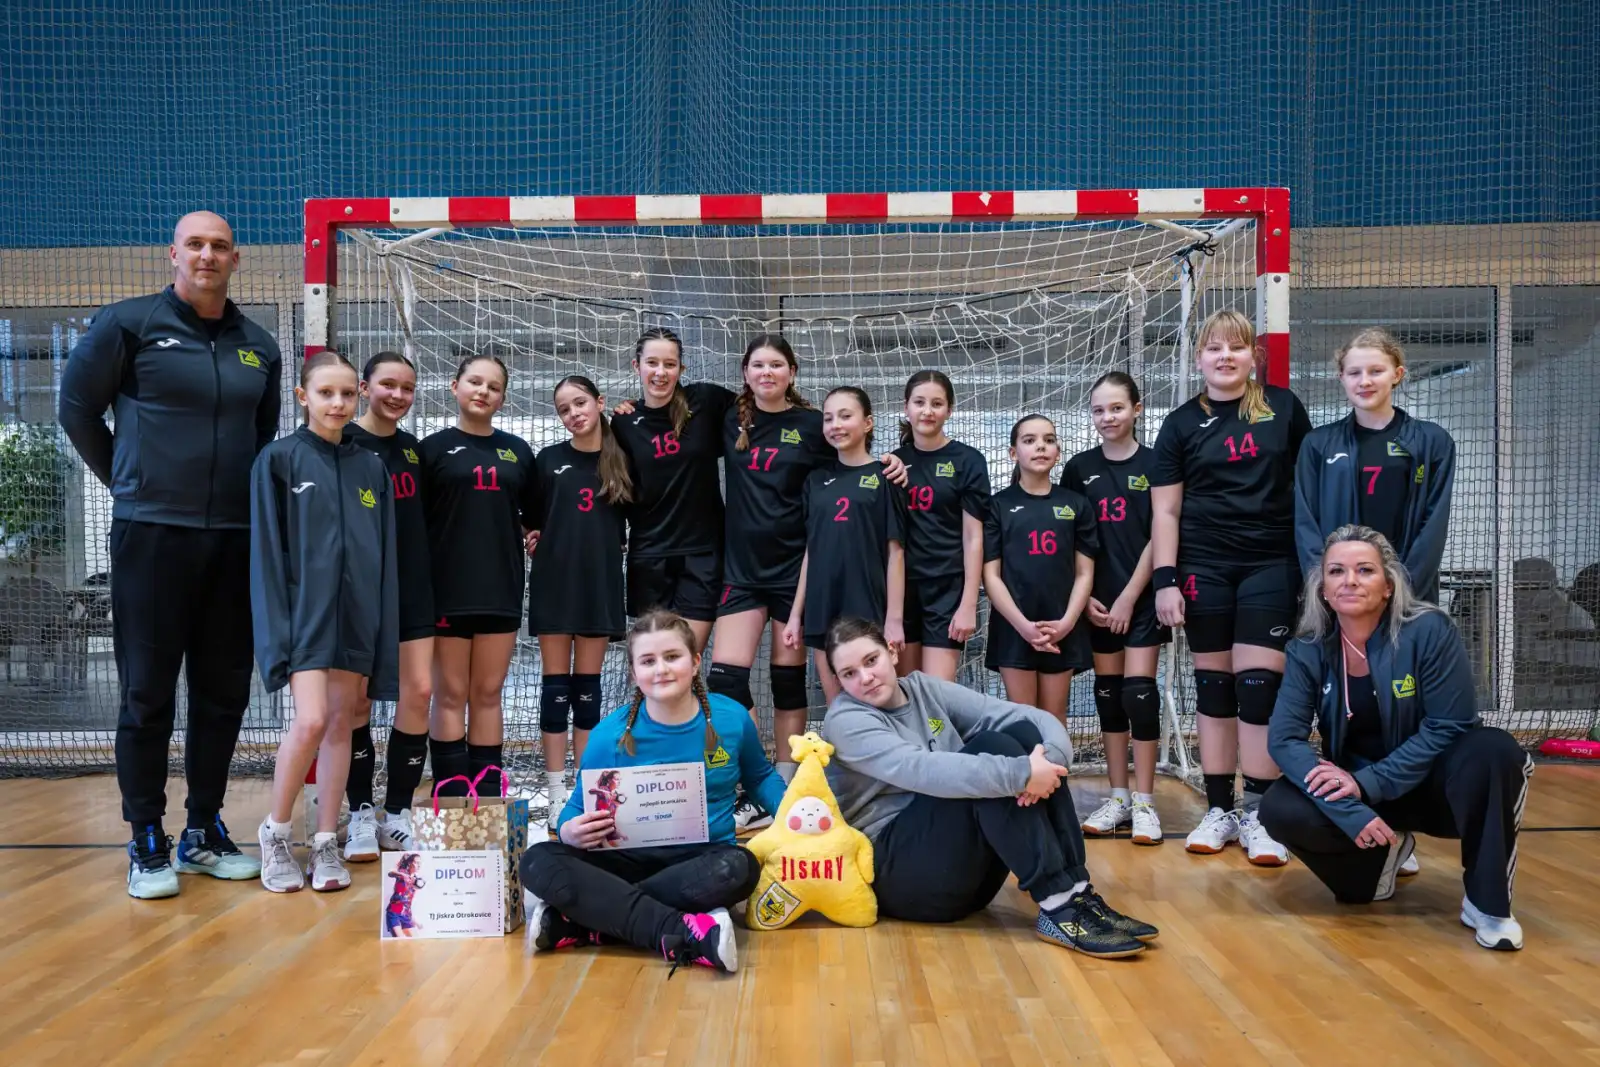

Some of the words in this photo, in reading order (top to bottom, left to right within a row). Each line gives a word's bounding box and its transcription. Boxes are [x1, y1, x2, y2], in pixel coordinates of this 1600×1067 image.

[651, 431, 681, 459] 18
[1225, 432, 1259, 462] 14
[747, 446, 779, 472] 17
[391, 471, 416, 500] 10
[473, 465, 501, 491] 11
[1363, 466, 1383, 495] 7
[577, 487, 594, 513] 3
[834, 496, 850, 522] 2
[908, 485, 934, 511] 19
[1098, 496, 1127, 522] 13
[1028, 530, 1058, 556] 16
[635, 780, 687, 794] DIPLOM
[435, 867, 486, 880] DIPLOM
[781, 855, 844, 882] JISKRY
[436, 912, 455, 920] Jiskra
[456, 911, 492, 919] Otrokovice
